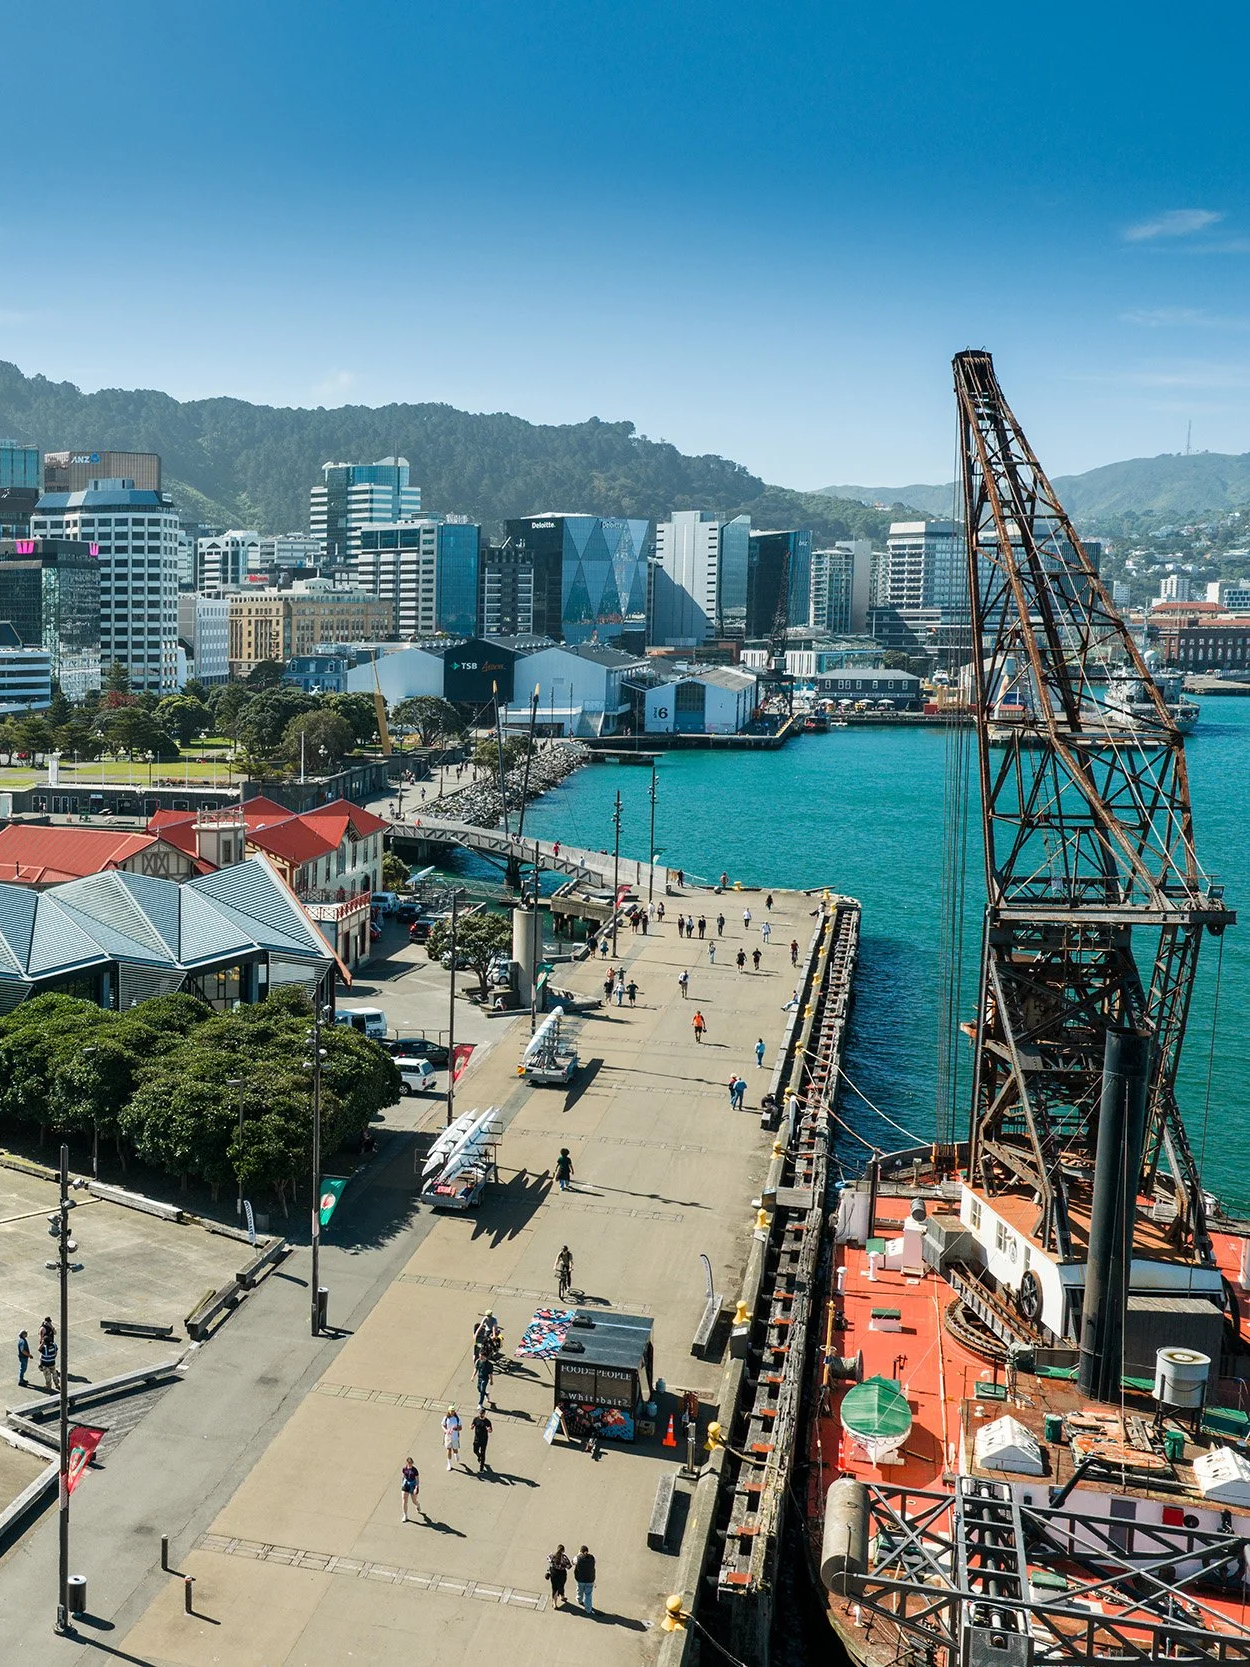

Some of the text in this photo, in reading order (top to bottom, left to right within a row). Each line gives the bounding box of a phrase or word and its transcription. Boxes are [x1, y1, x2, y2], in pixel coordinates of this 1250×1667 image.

[461, 662, 478, 670] TSB
[658, 707, 668, 719] 6
[561, 1364, 588, 1375] FOOD
[596, 1369, 632, 1381] PEOPLE
[568, 1392, 622, 1406] Whitebait
